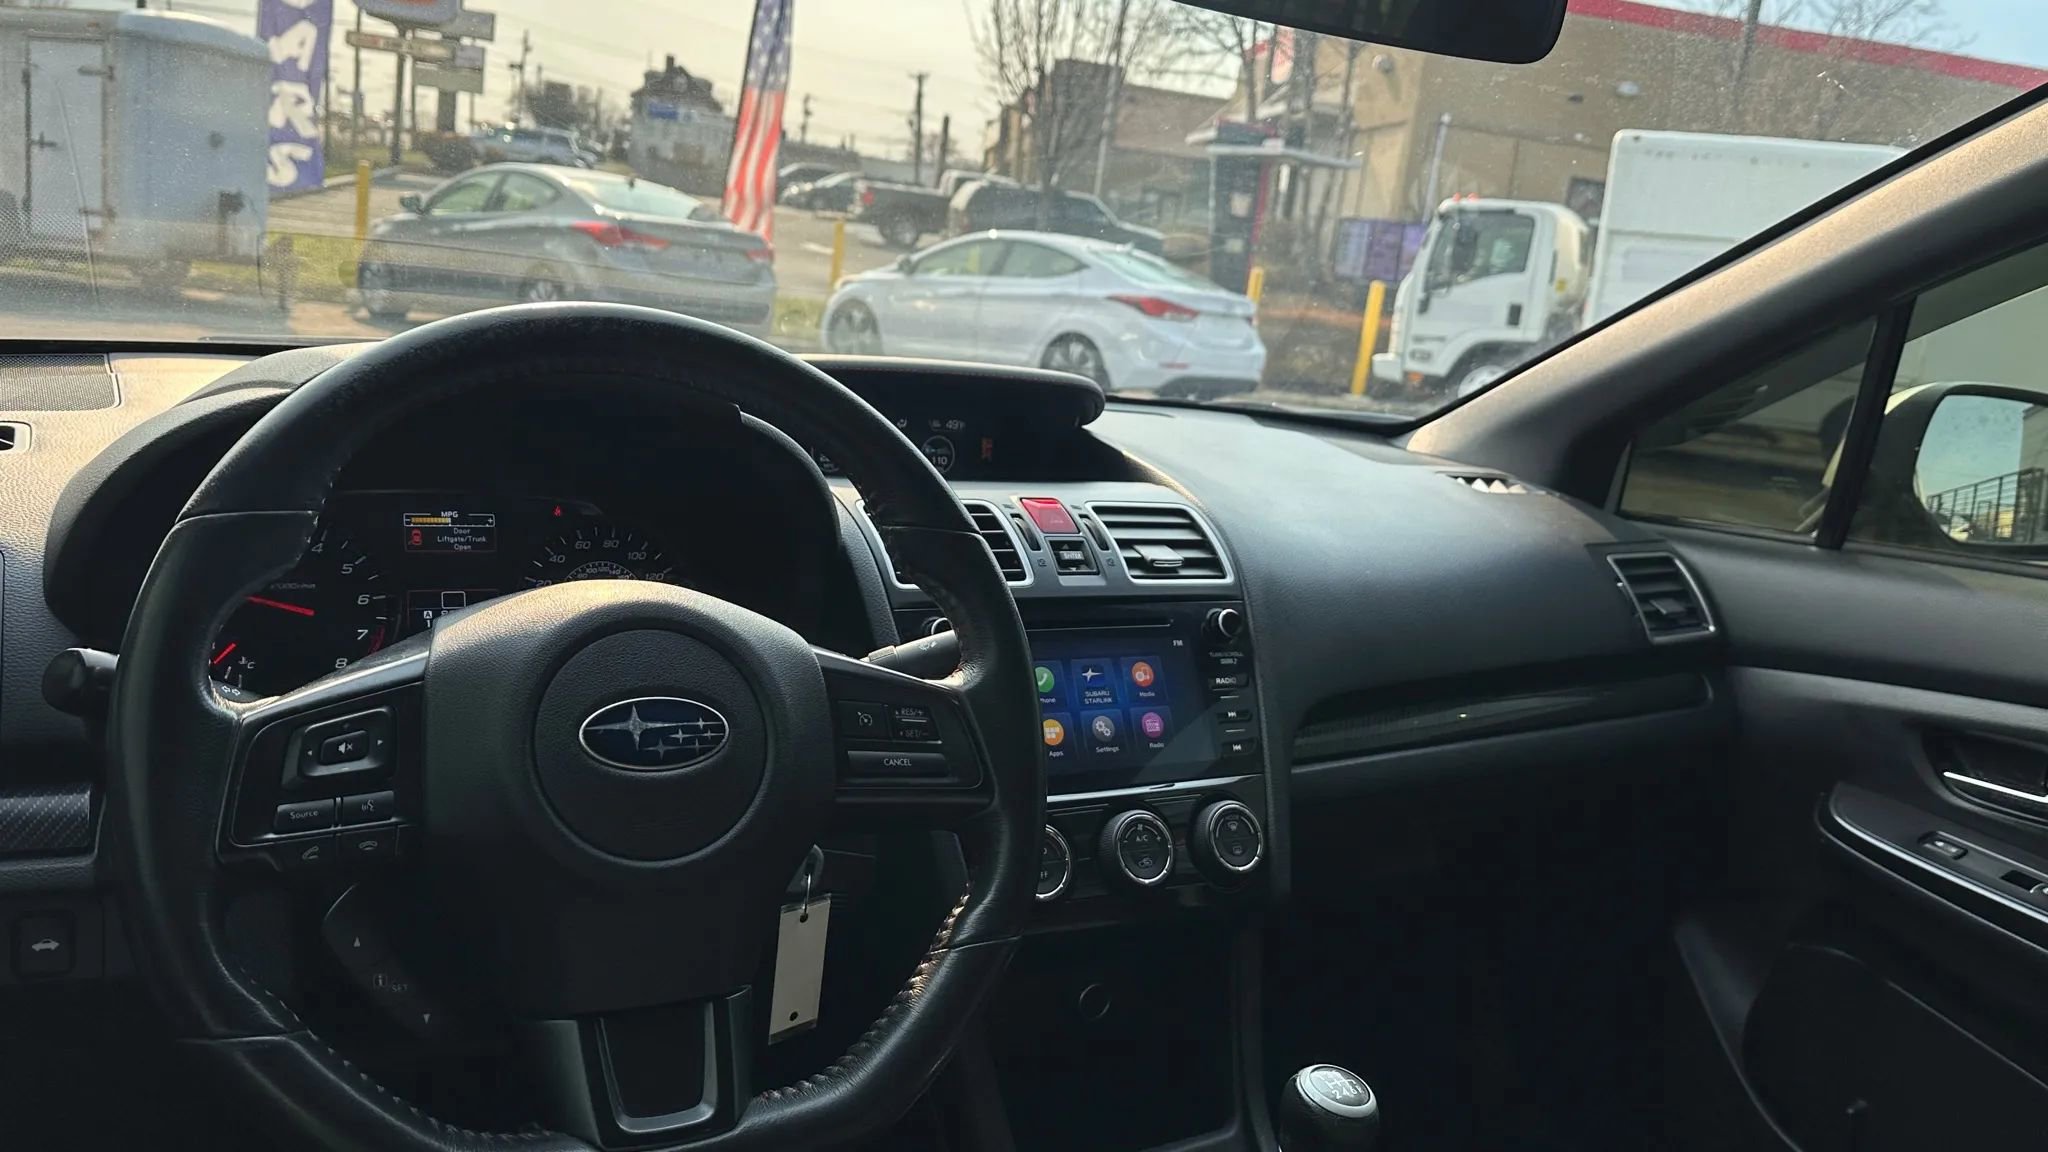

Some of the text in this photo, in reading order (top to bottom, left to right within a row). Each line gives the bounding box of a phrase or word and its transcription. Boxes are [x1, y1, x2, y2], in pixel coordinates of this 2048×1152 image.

[267, 0, 320, 188] ARS
[437, 536, 487, 544] Liftgate/Trunk
[603, 540, 620, 549] 80
[311, 542, 324, 553] 4
[454, 544, 472, 552] Open
[575, 540, 592, 550] 60
[549, 555, 566, 564] 40
[627, 551, 647, 561] 100
[341, 563, 354, 574] 5
[645, 572, 665, 581] 120
[357, 594, 369, 605] 6
[357, 629, 369, 640] 7
[335, 657, 348, 669] 8
[1215, 677, 1237, 685] RADIO
[1085, 690, 1109, 698] SUBARU
[1085, 697, 1113, 705] STARLINK
[1049, 750, 1064, 759] Apps
[1096, 746, 1120, 754] Settings
[883, 758, 913, 767] CANCEL
[290, 809, 320, 820] Source
[1135, 833, 1150, 842] A/C
